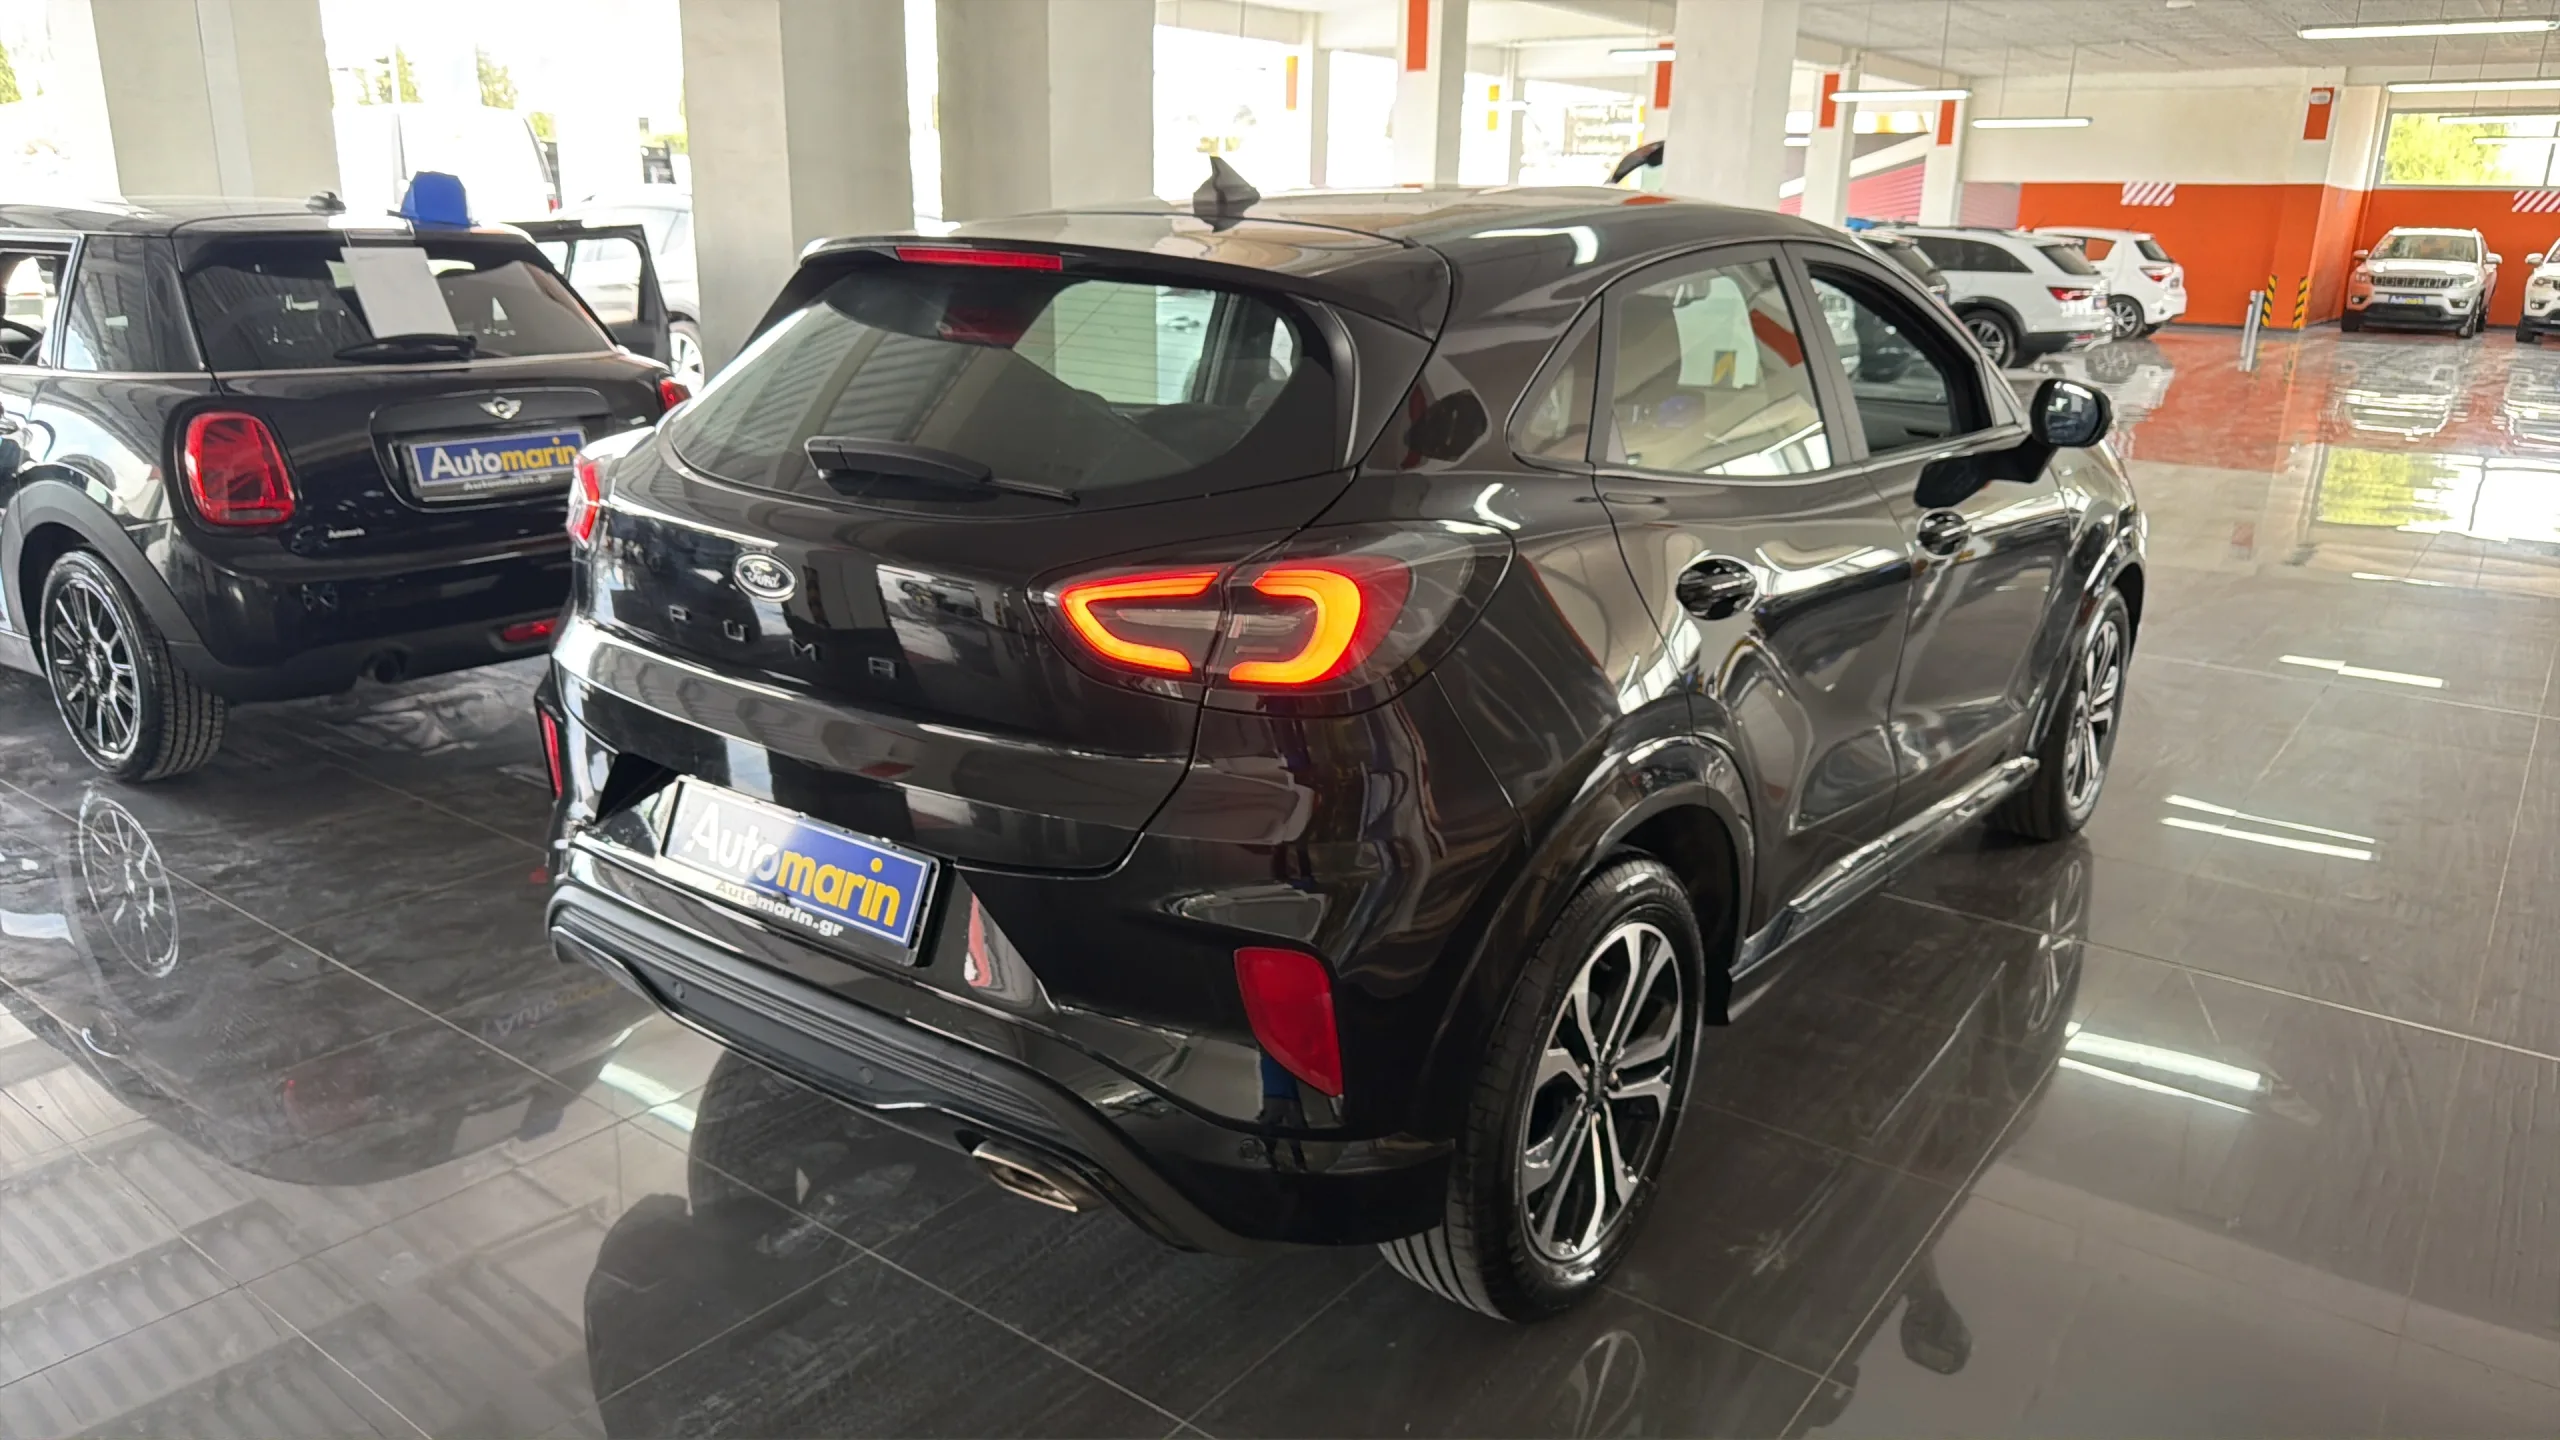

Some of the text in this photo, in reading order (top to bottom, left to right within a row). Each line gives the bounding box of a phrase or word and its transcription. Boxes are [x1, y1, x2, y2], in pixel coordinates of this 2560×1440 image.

[430, 437, 577, 480] Automarin
[746, 559, 781, 589] Ford
[683, 803, 901, 928] Automarin
[714, 878, 844, 938] Automarin.gr
